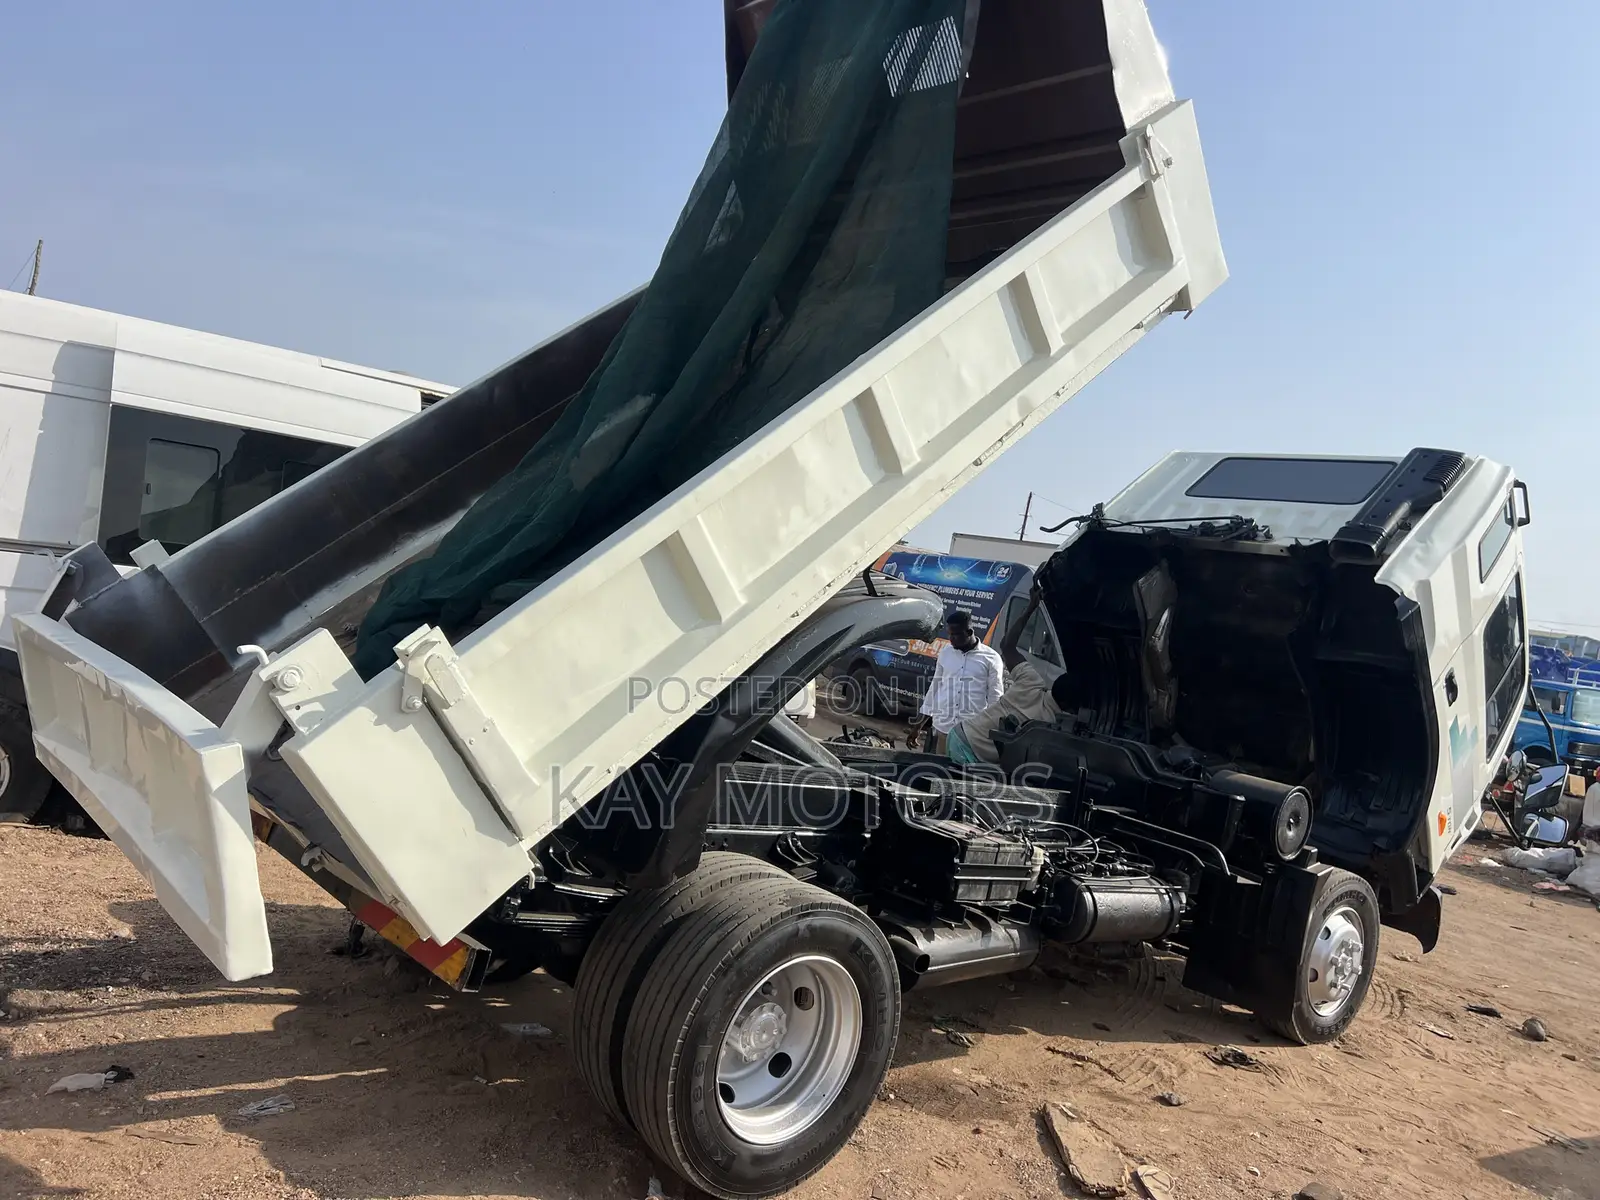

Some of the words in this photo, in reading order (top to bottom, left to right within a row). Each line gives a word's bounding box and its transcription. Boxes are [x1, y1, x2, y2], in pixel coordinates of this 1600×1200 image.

[938, 585, 960, 595] PLUMBERS
[964, 588, 976, 598] YOUR
[975, 590, 995, 600] SERVICE
